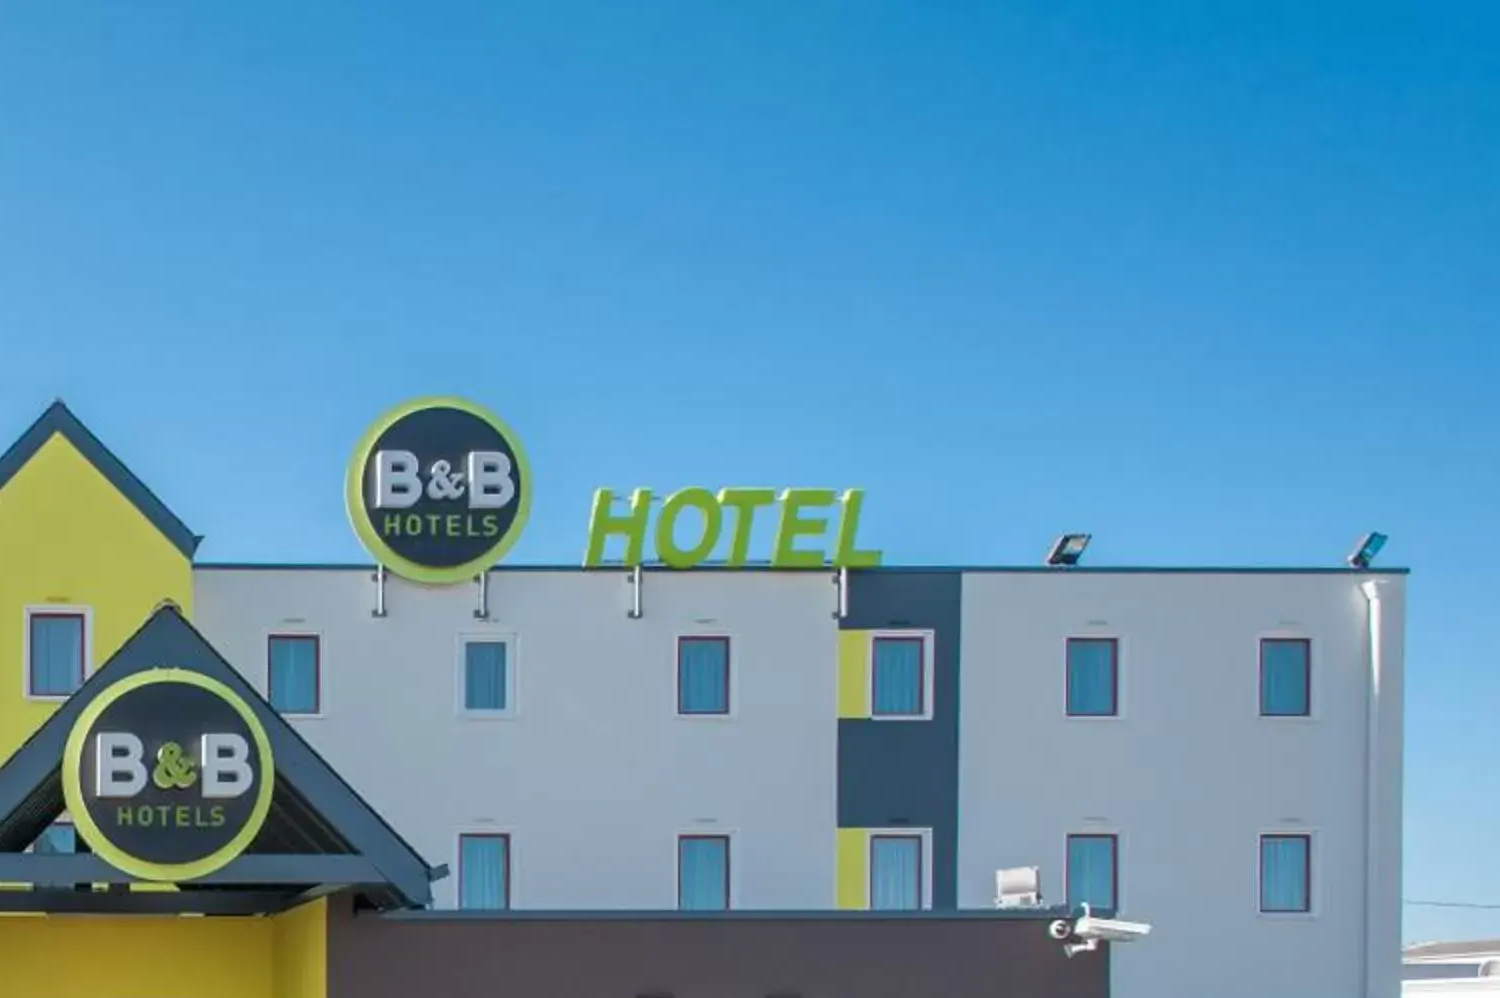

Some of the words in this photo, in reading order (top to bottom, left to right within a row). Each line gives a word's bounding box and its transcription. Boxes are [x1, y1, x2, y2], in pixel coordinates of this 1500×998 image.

[376, 450, 515, 509] B&B
[384, 513, 499, 537] HOTELS
[583, 486, 883, 569] HOTEL
[96, 732, 253, 798] B&B
[117, 805, 226, 827] HOTELS
